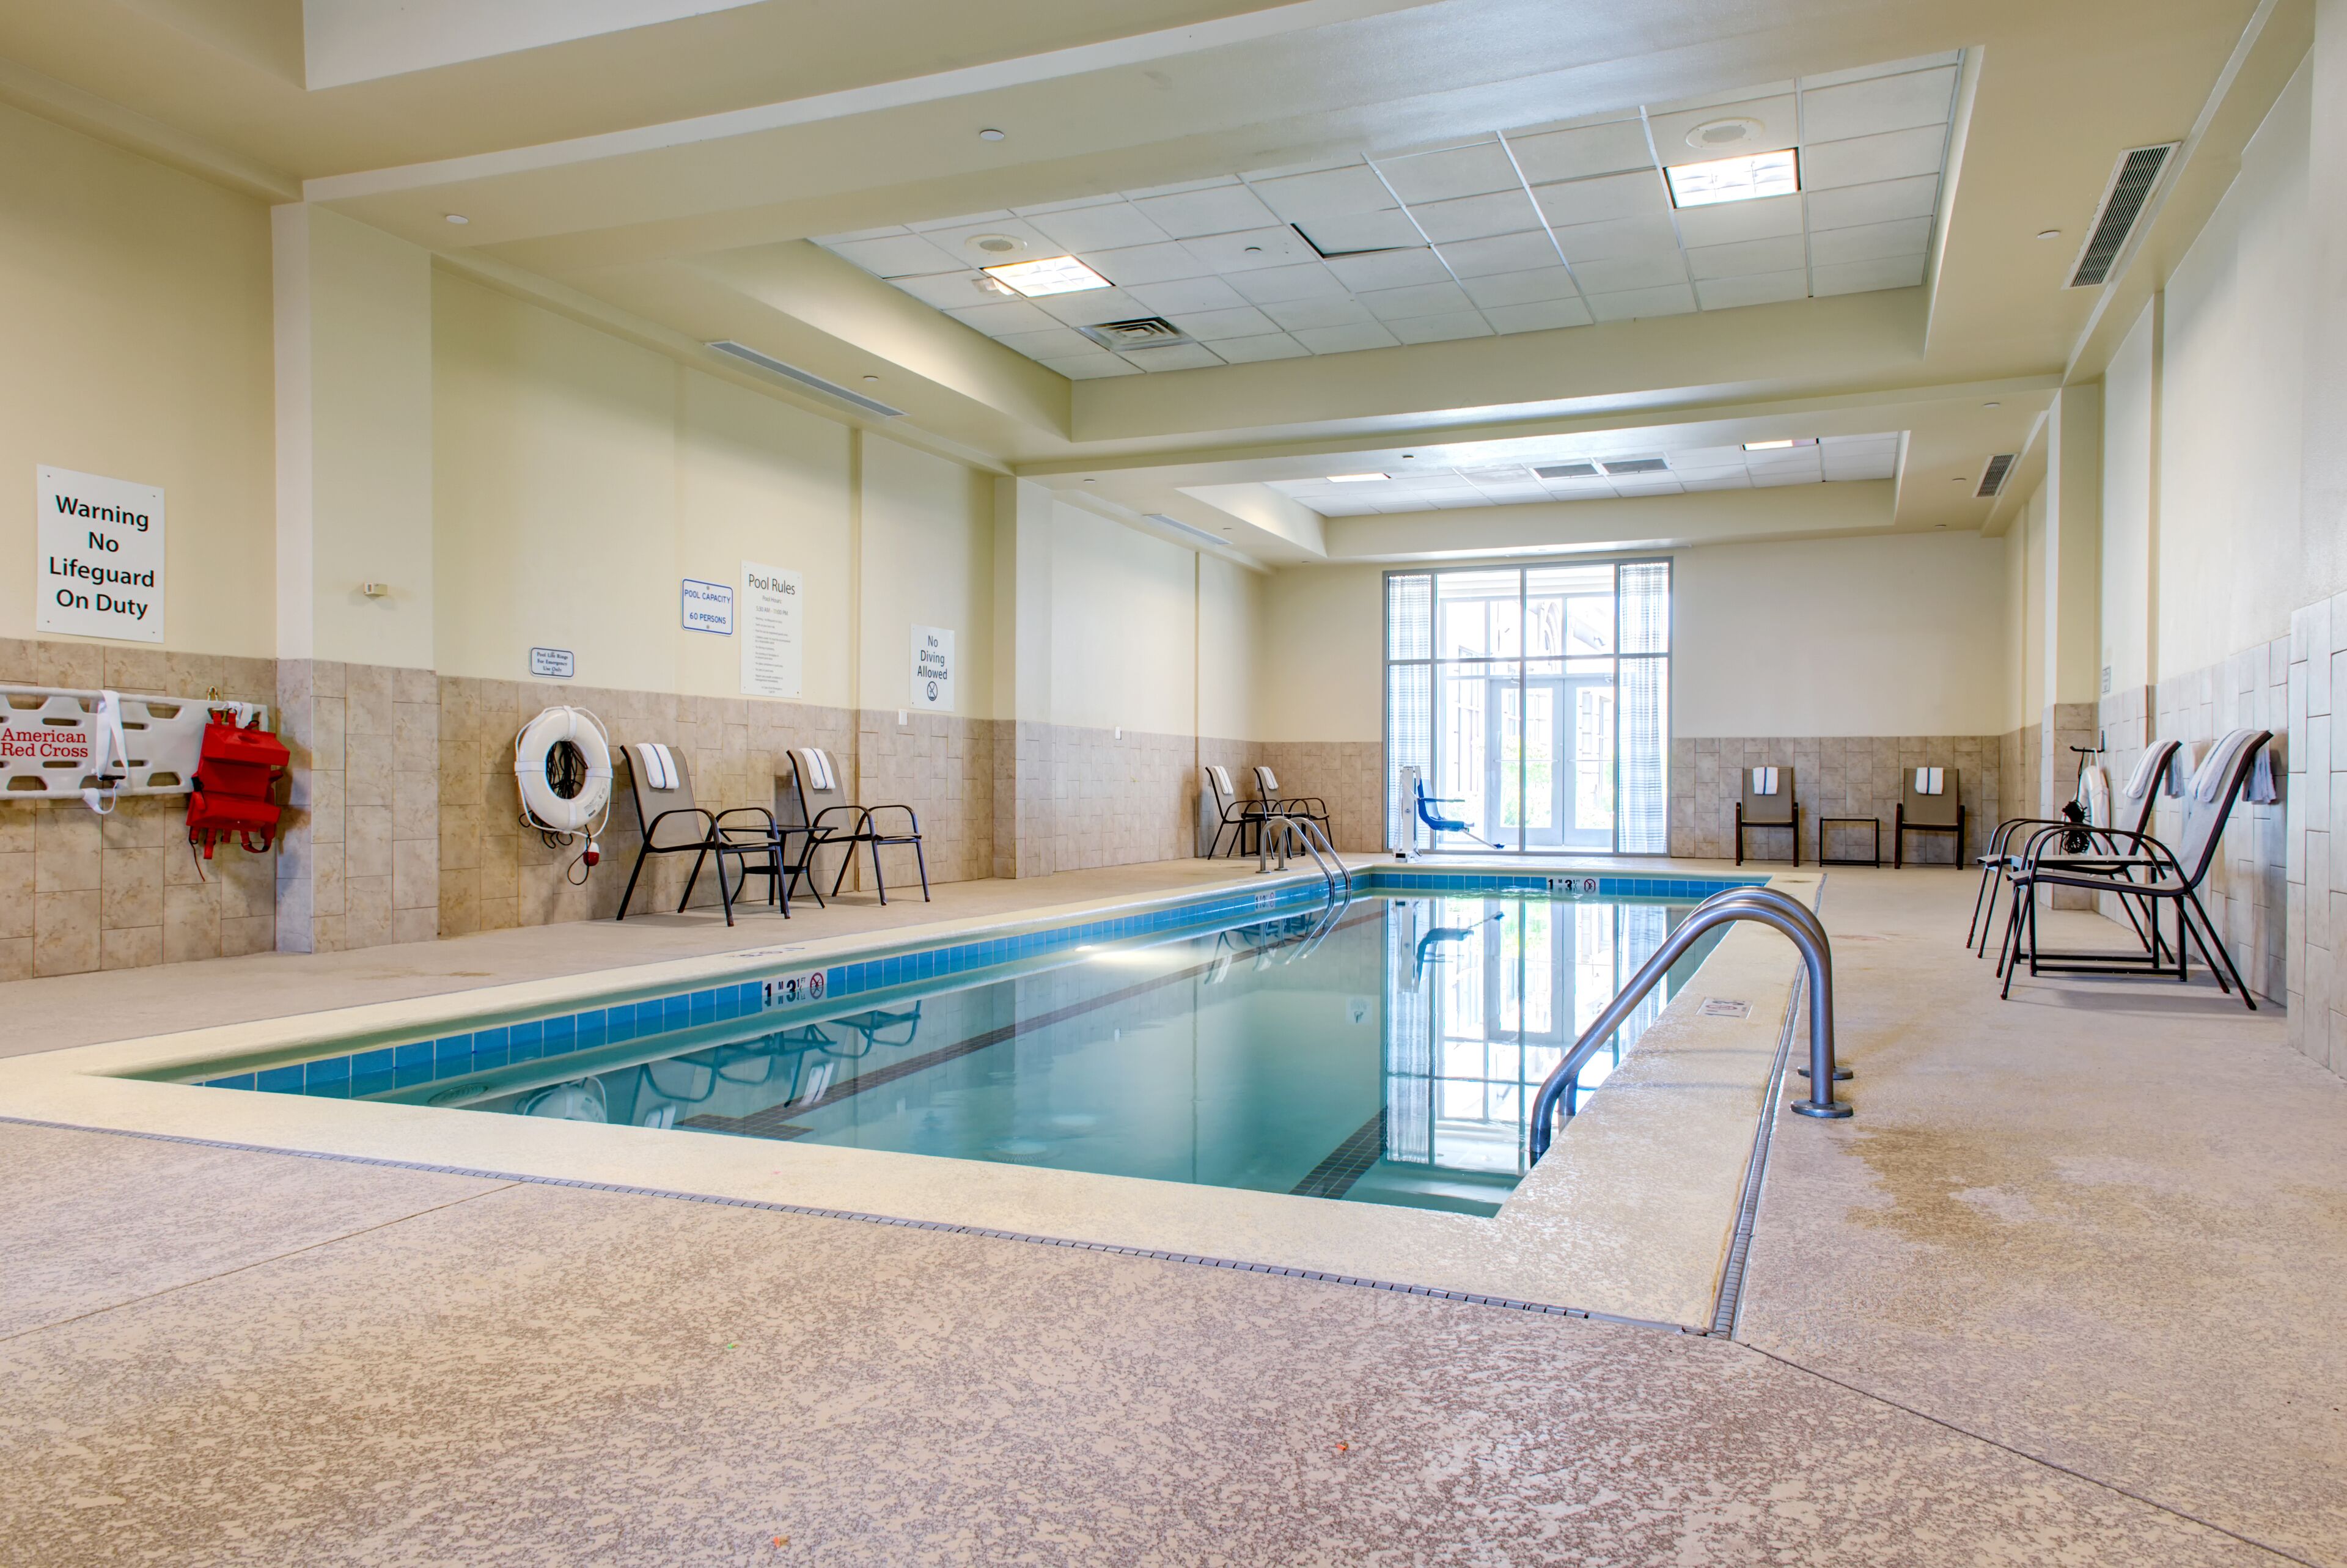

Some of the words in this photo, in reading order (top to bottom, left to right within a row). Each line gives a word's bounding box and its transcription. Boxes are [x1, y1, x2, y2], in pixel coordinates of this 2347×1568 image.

[55, 494, 149, 532] Warning
[88, 531, 120, 552] No
[50, 556, 155, 588] Lifeguard
[749, 573, 769, 591] Pool
[772, 578, 796, 595] Rules
[685, 589, 700, 599] POOL
[702, 592, 731, 604] CAPACITY
[56, 589, 89, 610] On
[96, 593, 149, 621] Duty
[699, 613, 726, 625] PERSONS
[928, 635, 938, 647] No
[920, 650, 945, 667] Diving
[917, 665, 947, 680] Allowed
[1, 728, 87, 744] American
[1, 742, 36, 757] Red
[40, 743, 89, 758] Cross
[778, 981, 784, 990] M
